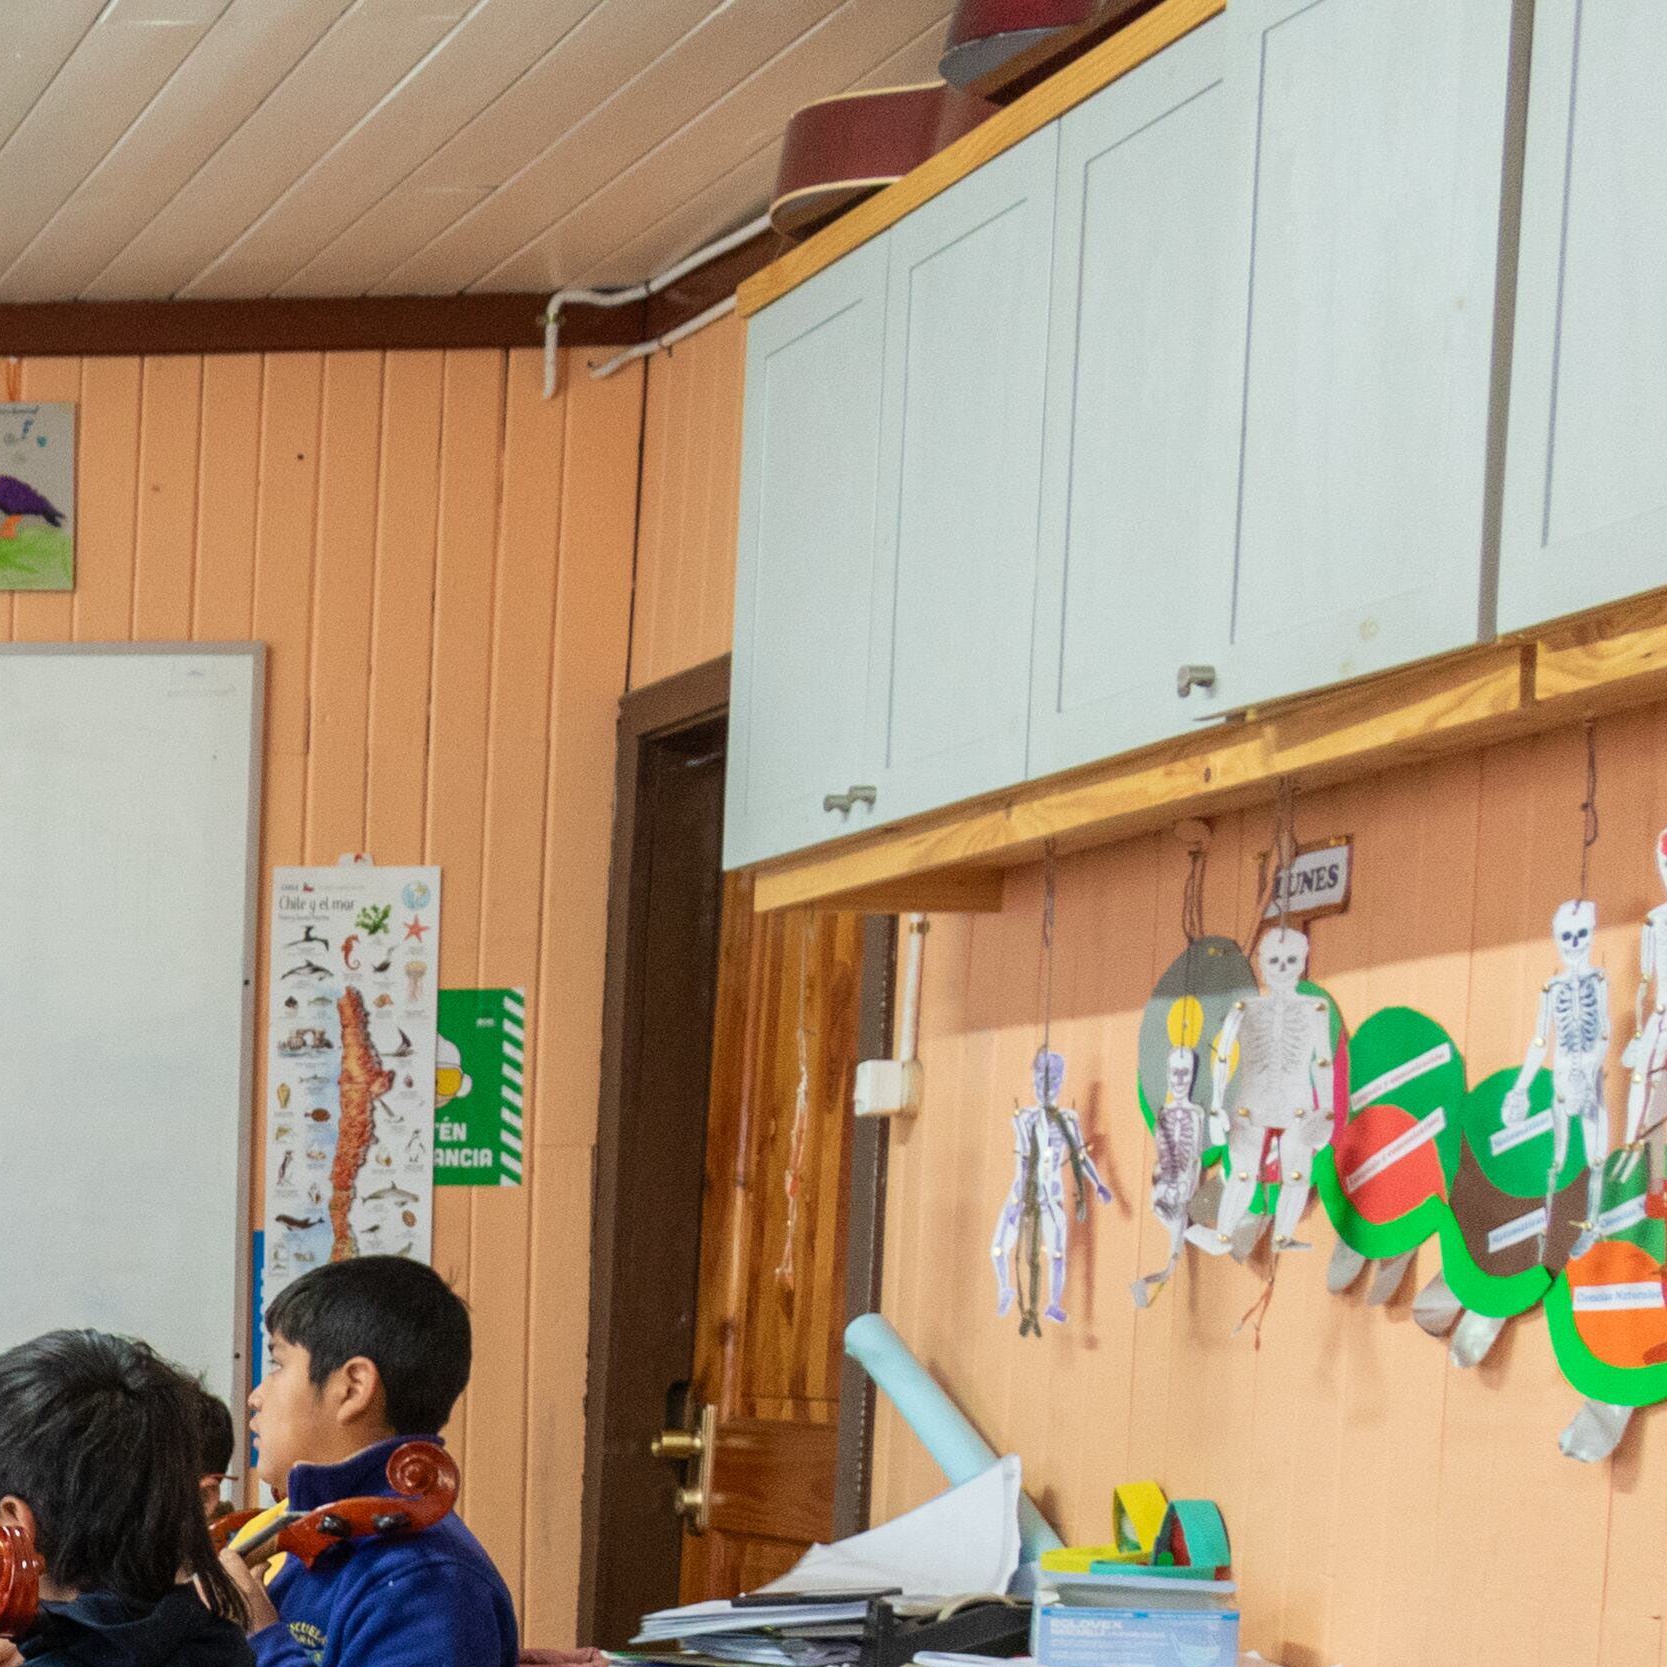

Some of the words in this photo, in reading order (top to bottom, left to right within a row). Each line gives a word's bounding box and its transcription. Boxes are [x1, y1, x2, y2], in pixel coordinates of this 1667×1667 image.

[278, 895, 307, 911] Chile
[309, 900, 317, 912] y
[318, 895, 329, 910] el
[331, 900, 356, 911] mar
